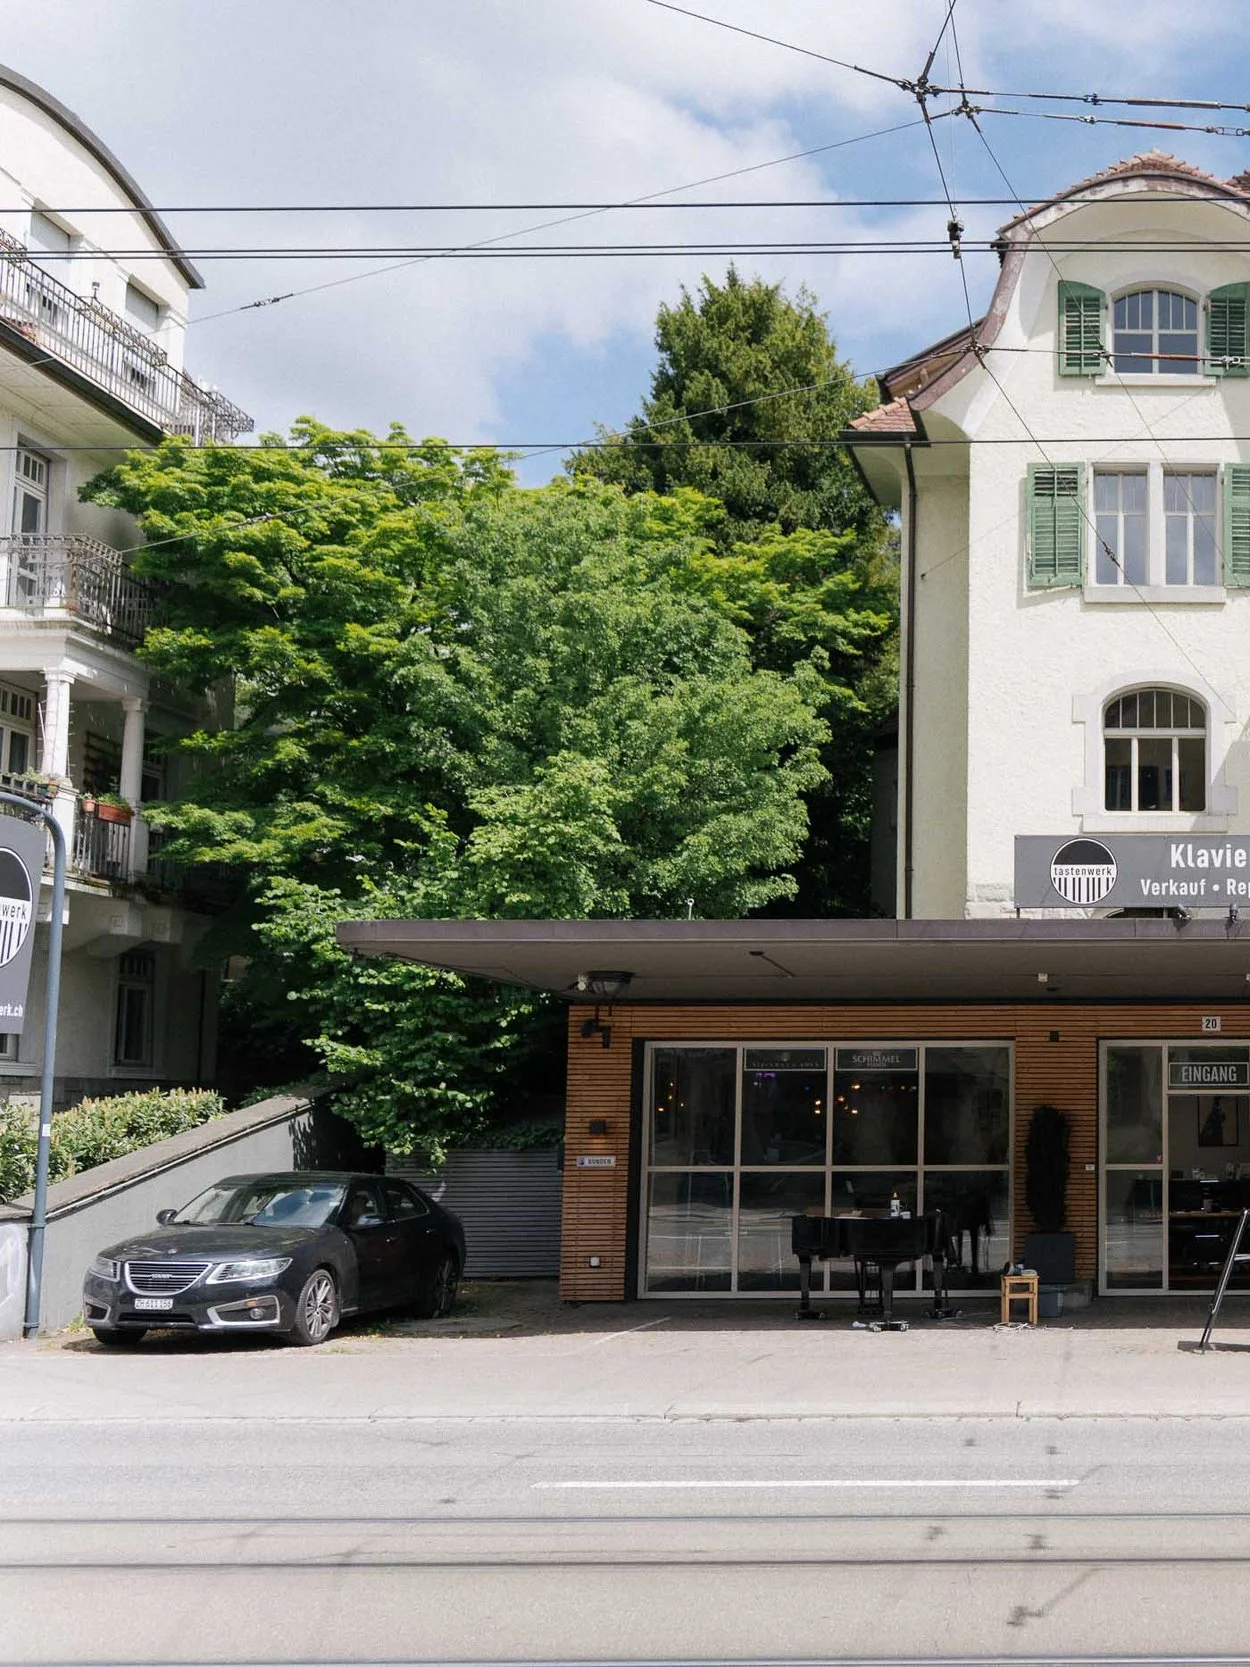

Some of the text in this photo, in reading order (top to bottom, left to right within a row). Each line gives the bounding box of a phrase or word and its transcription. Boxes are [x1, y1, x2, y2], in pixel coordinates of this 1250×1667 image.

[1054, 867, 1112, 876] tastenwerk
[1140, 878, 1206, 896] Verkauf
[1205, 1018, 1217, 1029] 20
[852, 1055, 901, 1064] SCHIMMEL
[1181, 1065, 1237, 1082] EINGANG
